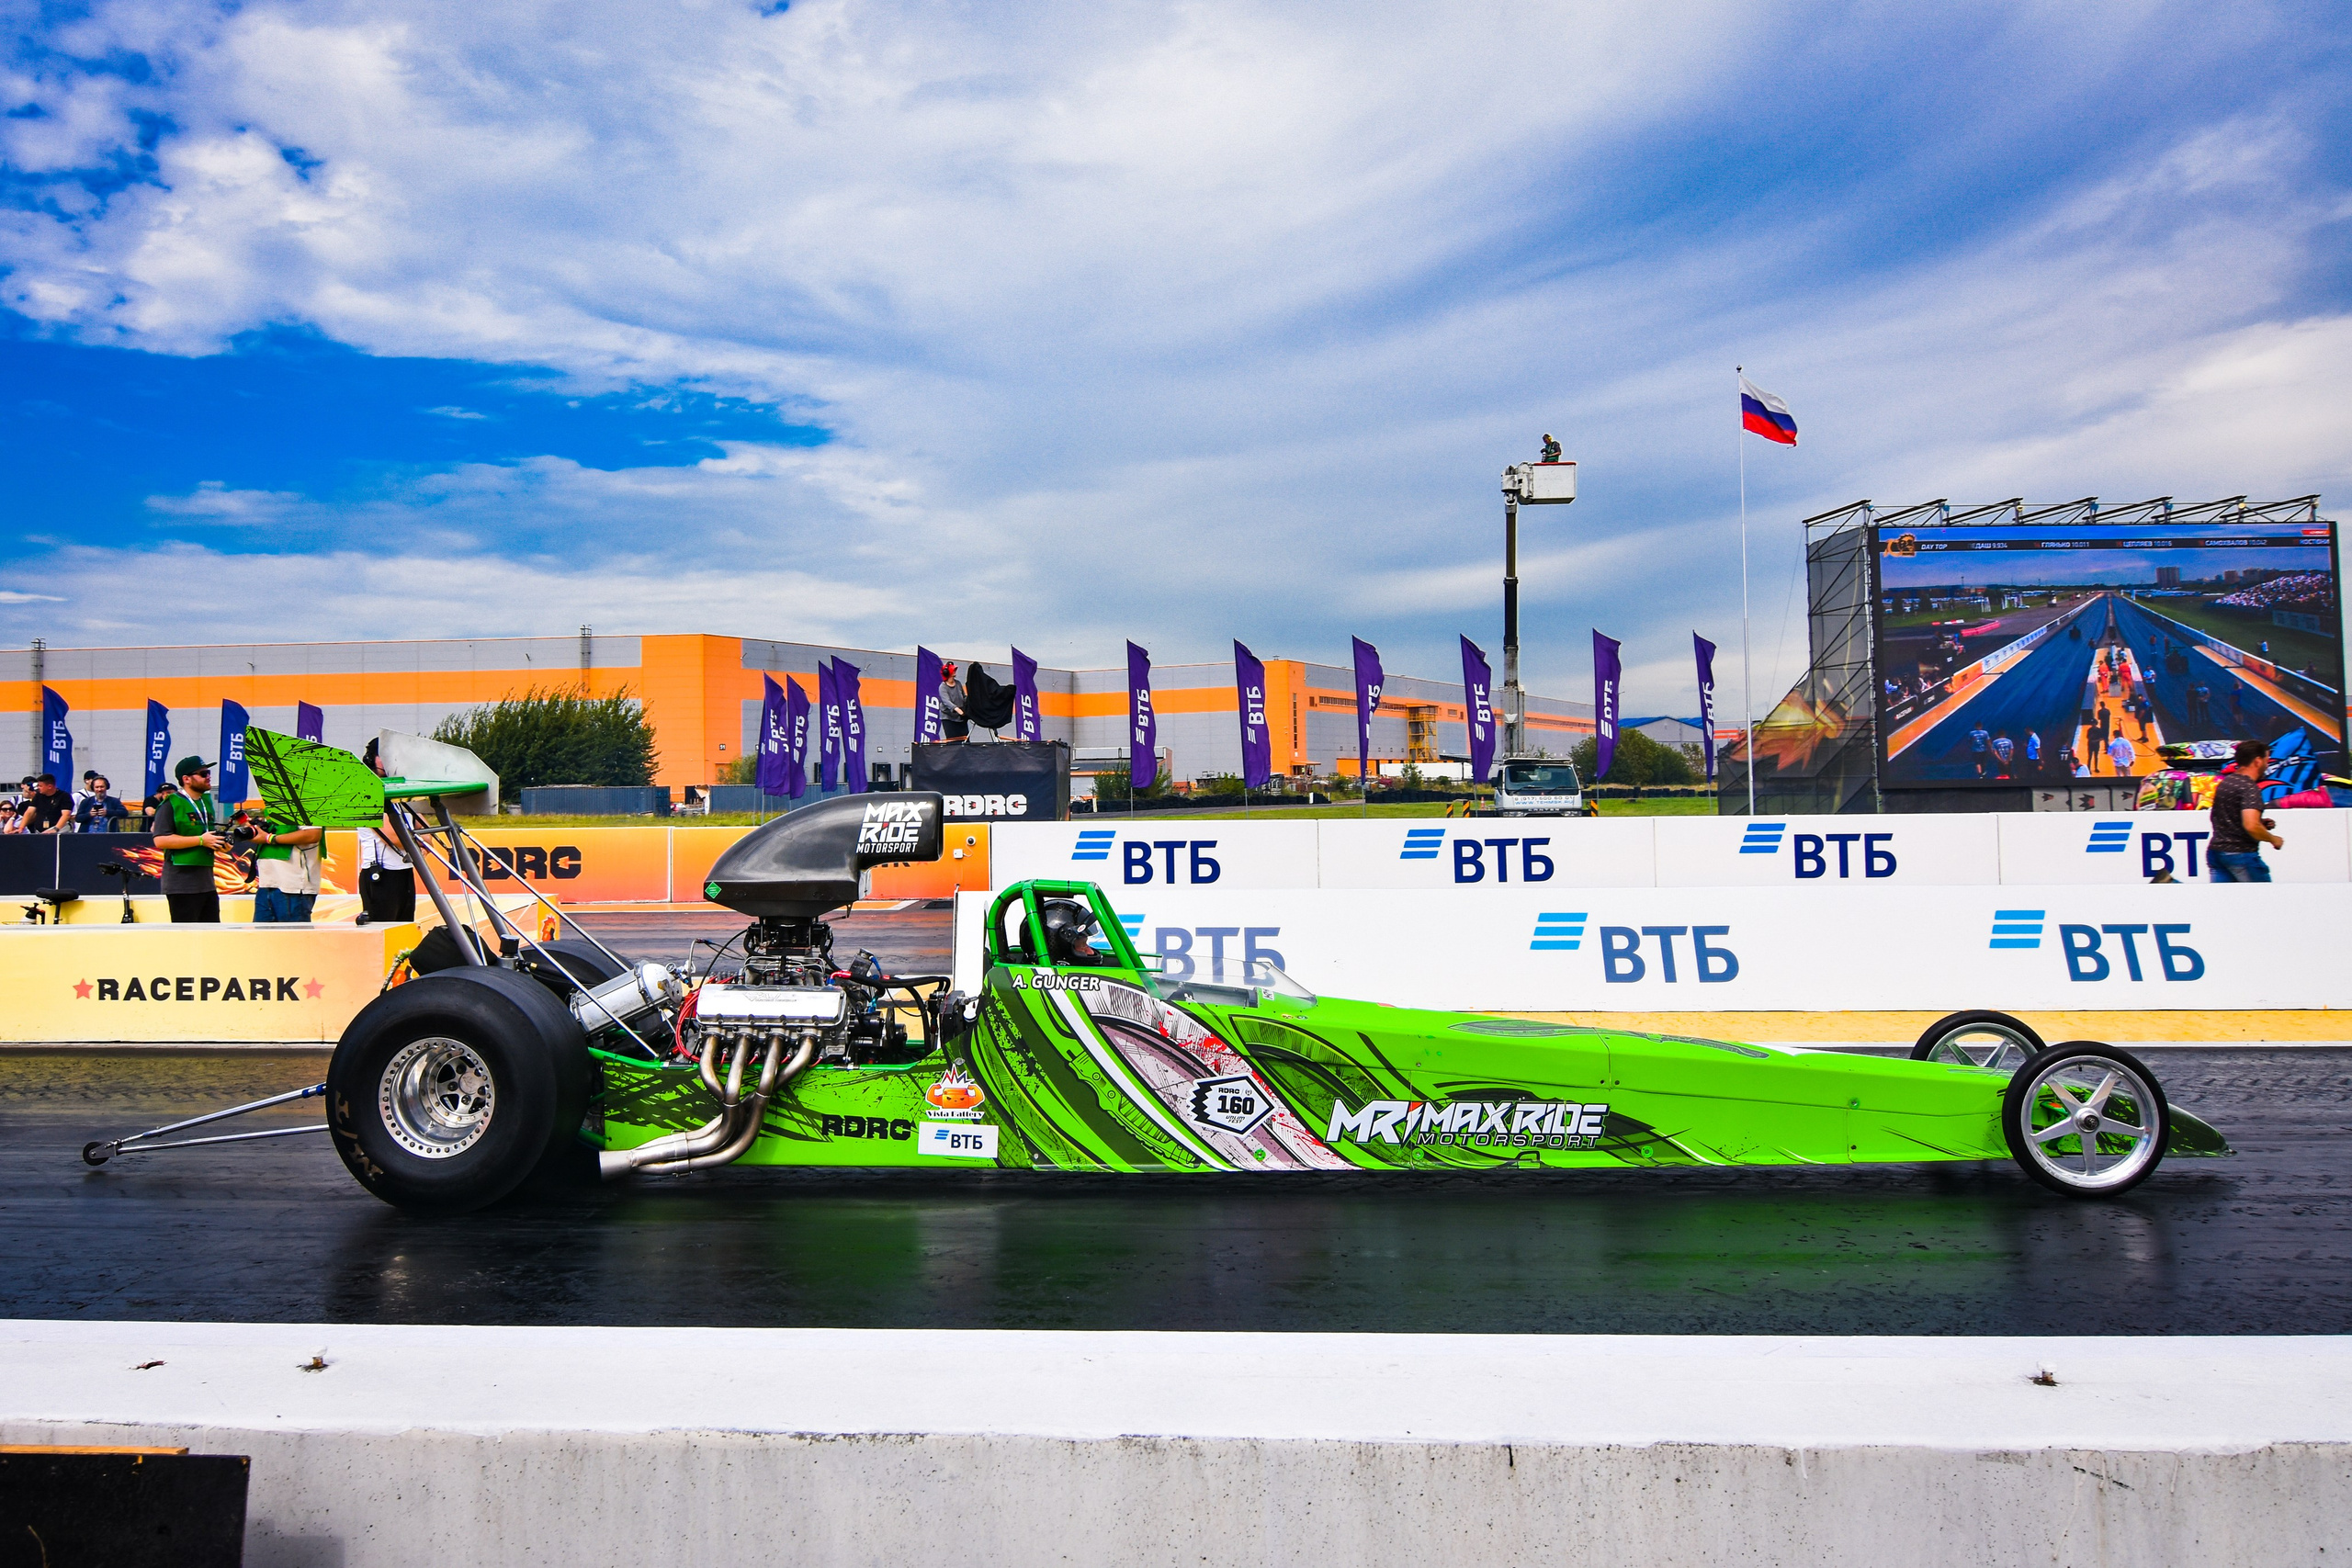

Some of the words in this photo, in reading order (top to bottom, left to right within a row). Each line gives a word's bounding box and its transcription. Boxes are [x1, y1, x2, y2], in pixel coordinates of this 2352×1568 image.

[924, 695, 940, 735] ВТБ
[1022, 694, 1035, 734] ВТБ
[1136, 689, 1149, 728] ВТБ
[1246, 685, 1265, 725] ВТБ
[52, 720, 67, 750] ВТБ
[827, 705, 840, 738] ВТБ
[152, 731, 165, 761] ВТБ
[230, 733, 244, 761] ВТБ
[864, 801, 927, 822] MAX
[944, 794, 1027, 816] RDRC
[856, 842, 918, 854] MOTORSPORT
[1123, 840, 1221, 885] ВТБ
[1453, 837, 1555, 884] ВТБ
[1793, 832, 1898, 879] ВТБ
[2141, 831, 2210, 878] ВТ
[1155, 927, 1285, 987] ВТБ
[1600, 925, 1740, 983] ВТБ
[2058, 923, 2205, 982] ВТБ
[96, 976, 300, 1001] RACEPARK
[1012, 975, 1027, 988] A.
[1032, 975, 1100, 990] GUNGER
[951, 1111, 984, 1119] Battery
[1217, 1095, 1255, 1115] 160
[1419, 1101, 1514, 1134] MAX
[822, 1113, 911, 1141] RDRC
[951, 1134, 983, 1150] ВТБ
[1418, 1133, 1600, 1148] MOTORSPORT
